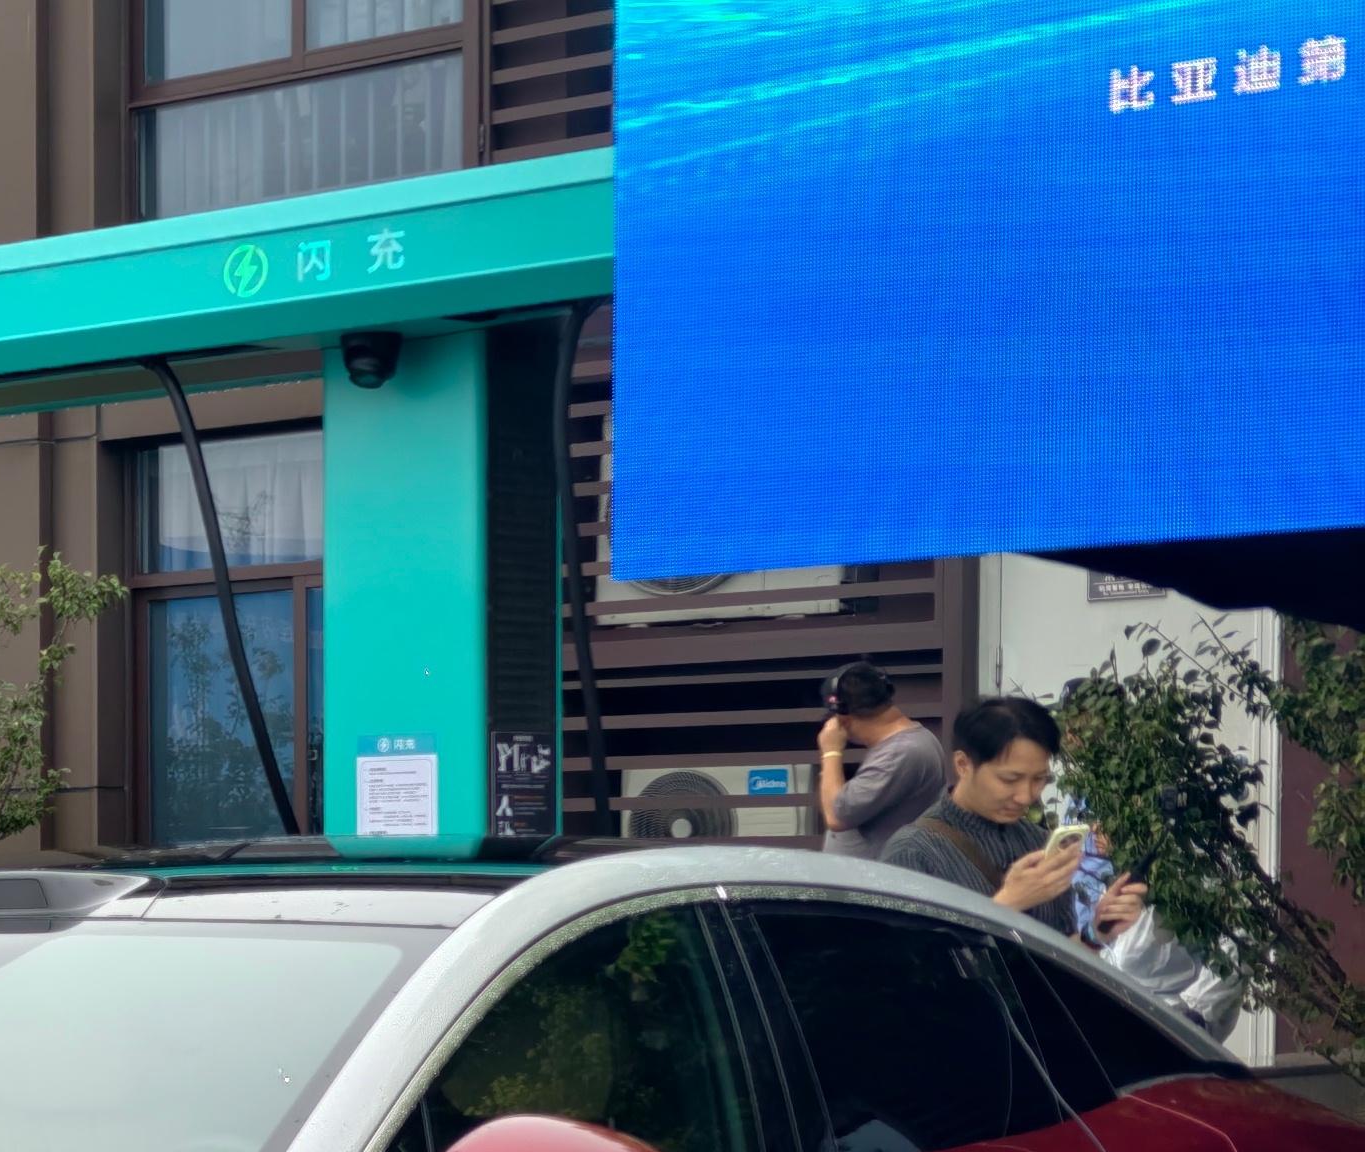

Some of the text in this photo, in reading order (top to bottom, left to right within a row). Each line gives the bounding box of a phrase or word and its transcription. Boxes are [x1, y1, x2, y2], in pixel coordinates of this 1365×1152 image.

[1109, 35, 1347, 114] 比亚迪第
[297, 230, 405, 281] 闪充
